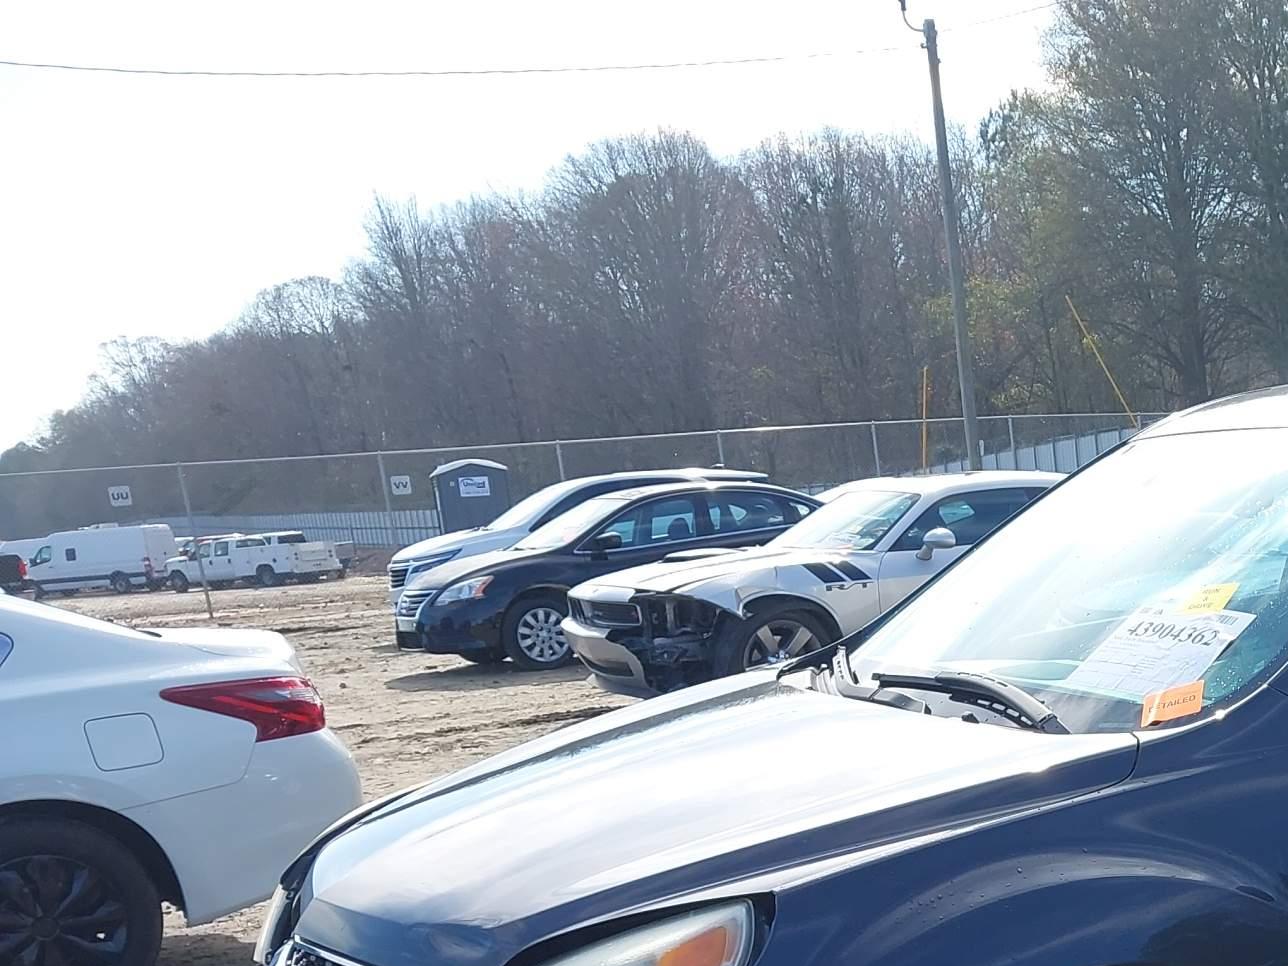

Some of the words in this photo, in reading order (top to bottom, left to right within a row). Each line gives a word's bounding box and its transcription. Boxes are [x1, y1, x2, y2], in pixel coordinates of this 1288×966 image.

[393, 481, 408, 489] VV
[112, 491, 129, 500] UU
[1128, 620, 1219, 647] 43904362
